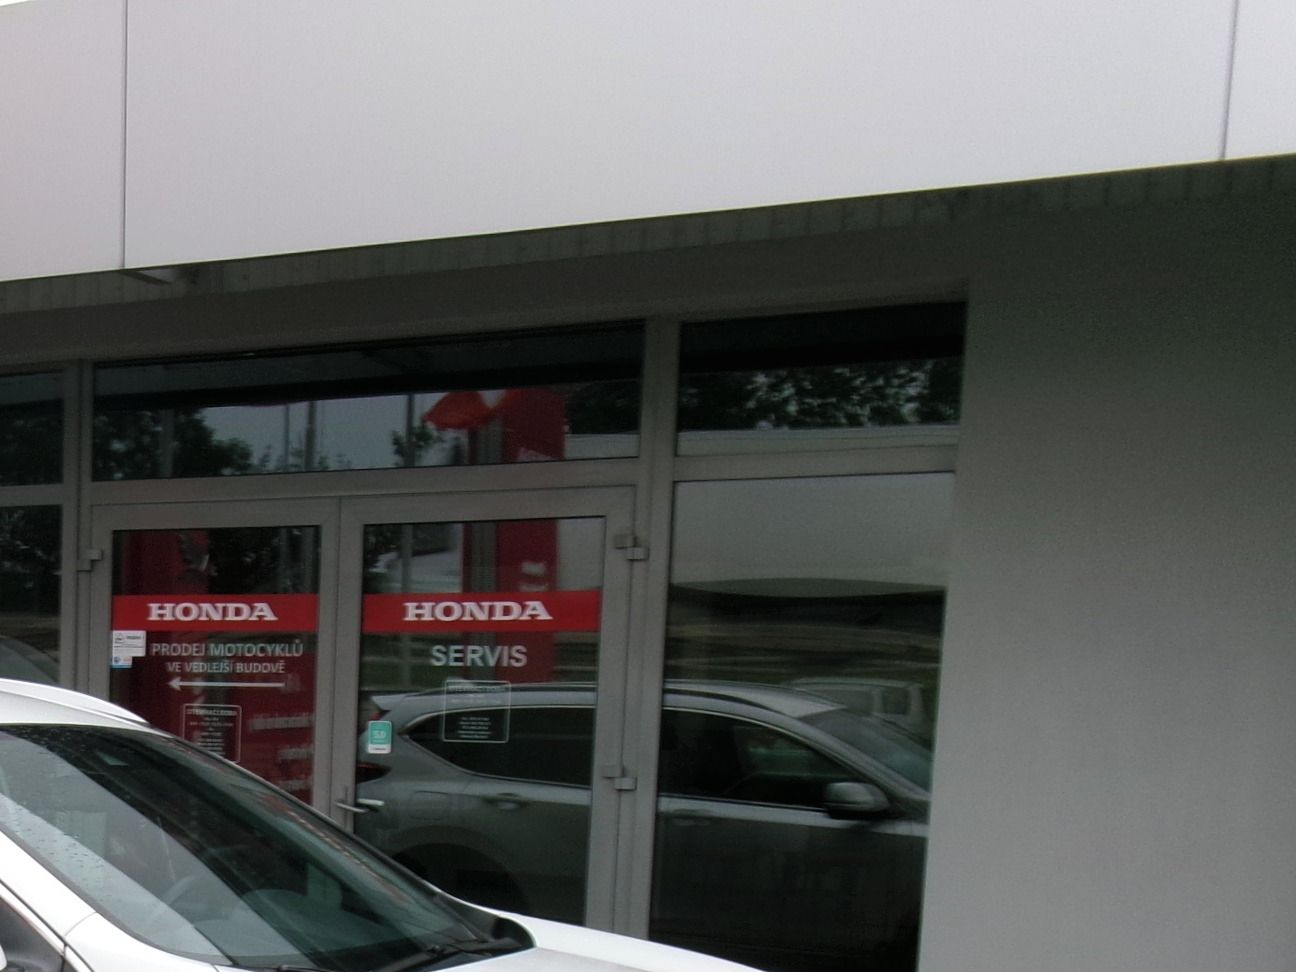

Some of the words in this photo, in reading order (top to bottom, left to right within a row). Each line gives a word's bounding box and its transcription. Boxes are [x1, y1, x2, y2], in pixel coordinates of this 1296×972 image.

[147, 602, 279, 621] HONDA
[403, 600, 553, 622] HONDA
[152, 642, 205, 657] PRODEJ
[207, 638, 304, 657] MOTOCYKLŮ
[430, 644, 528, 667] SERVIS
[167, 661, 182, 673] VE
[184, 658, 234, 674] VEDLEJŠÍ
[236, 660, 286, 674] BUDOVĚ
